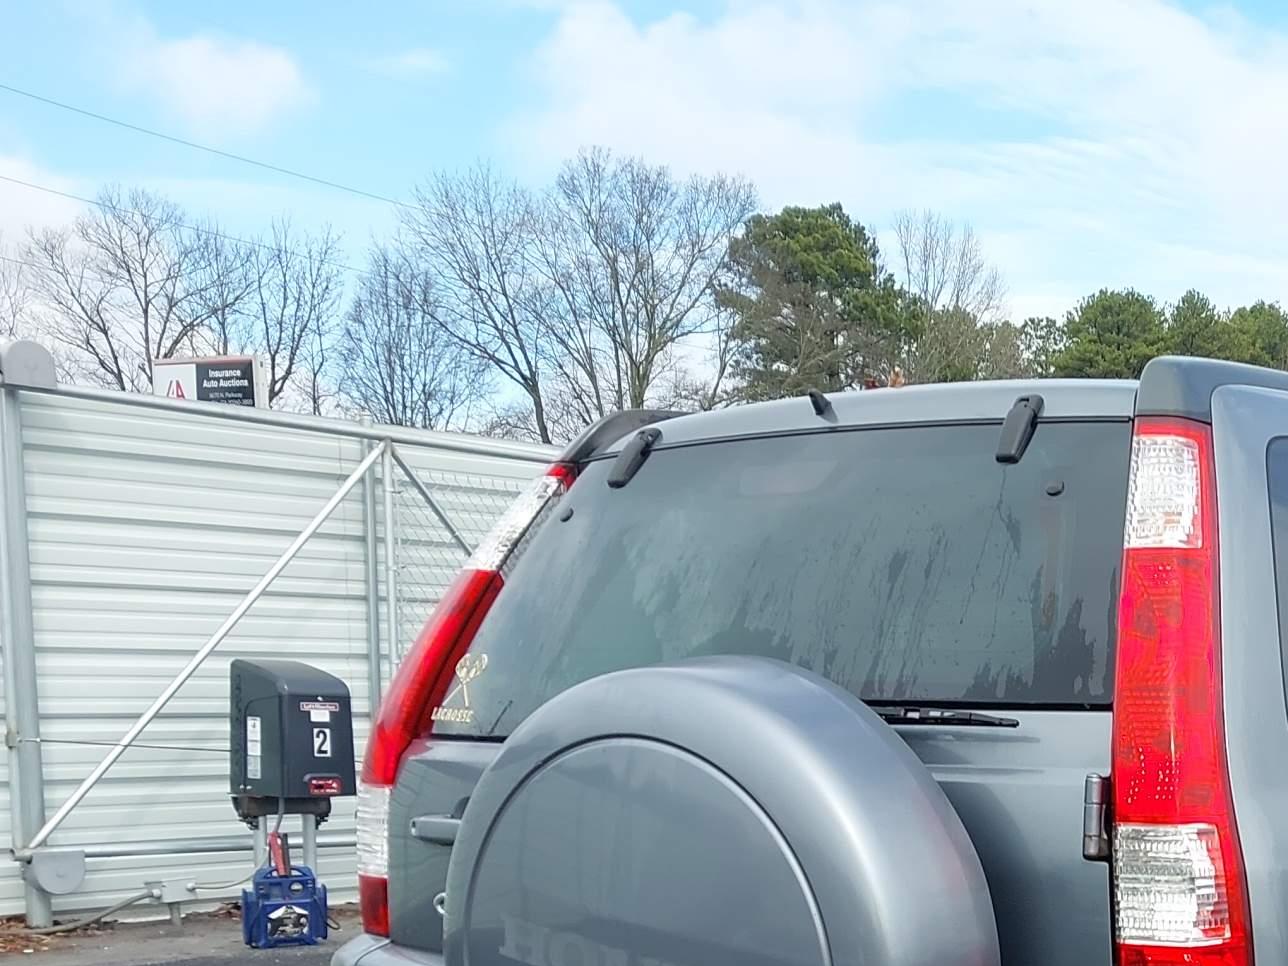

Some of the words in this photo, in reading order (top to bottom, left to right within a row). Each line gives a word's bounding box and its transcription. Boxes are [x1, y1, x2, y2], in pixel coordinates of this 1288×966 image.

[209, 369, 241, 377] Insurance
[203, 379, 218, 388] Auto
[219, 378, 248, 387] Auctions
[316, 730, 328, 754] 2
